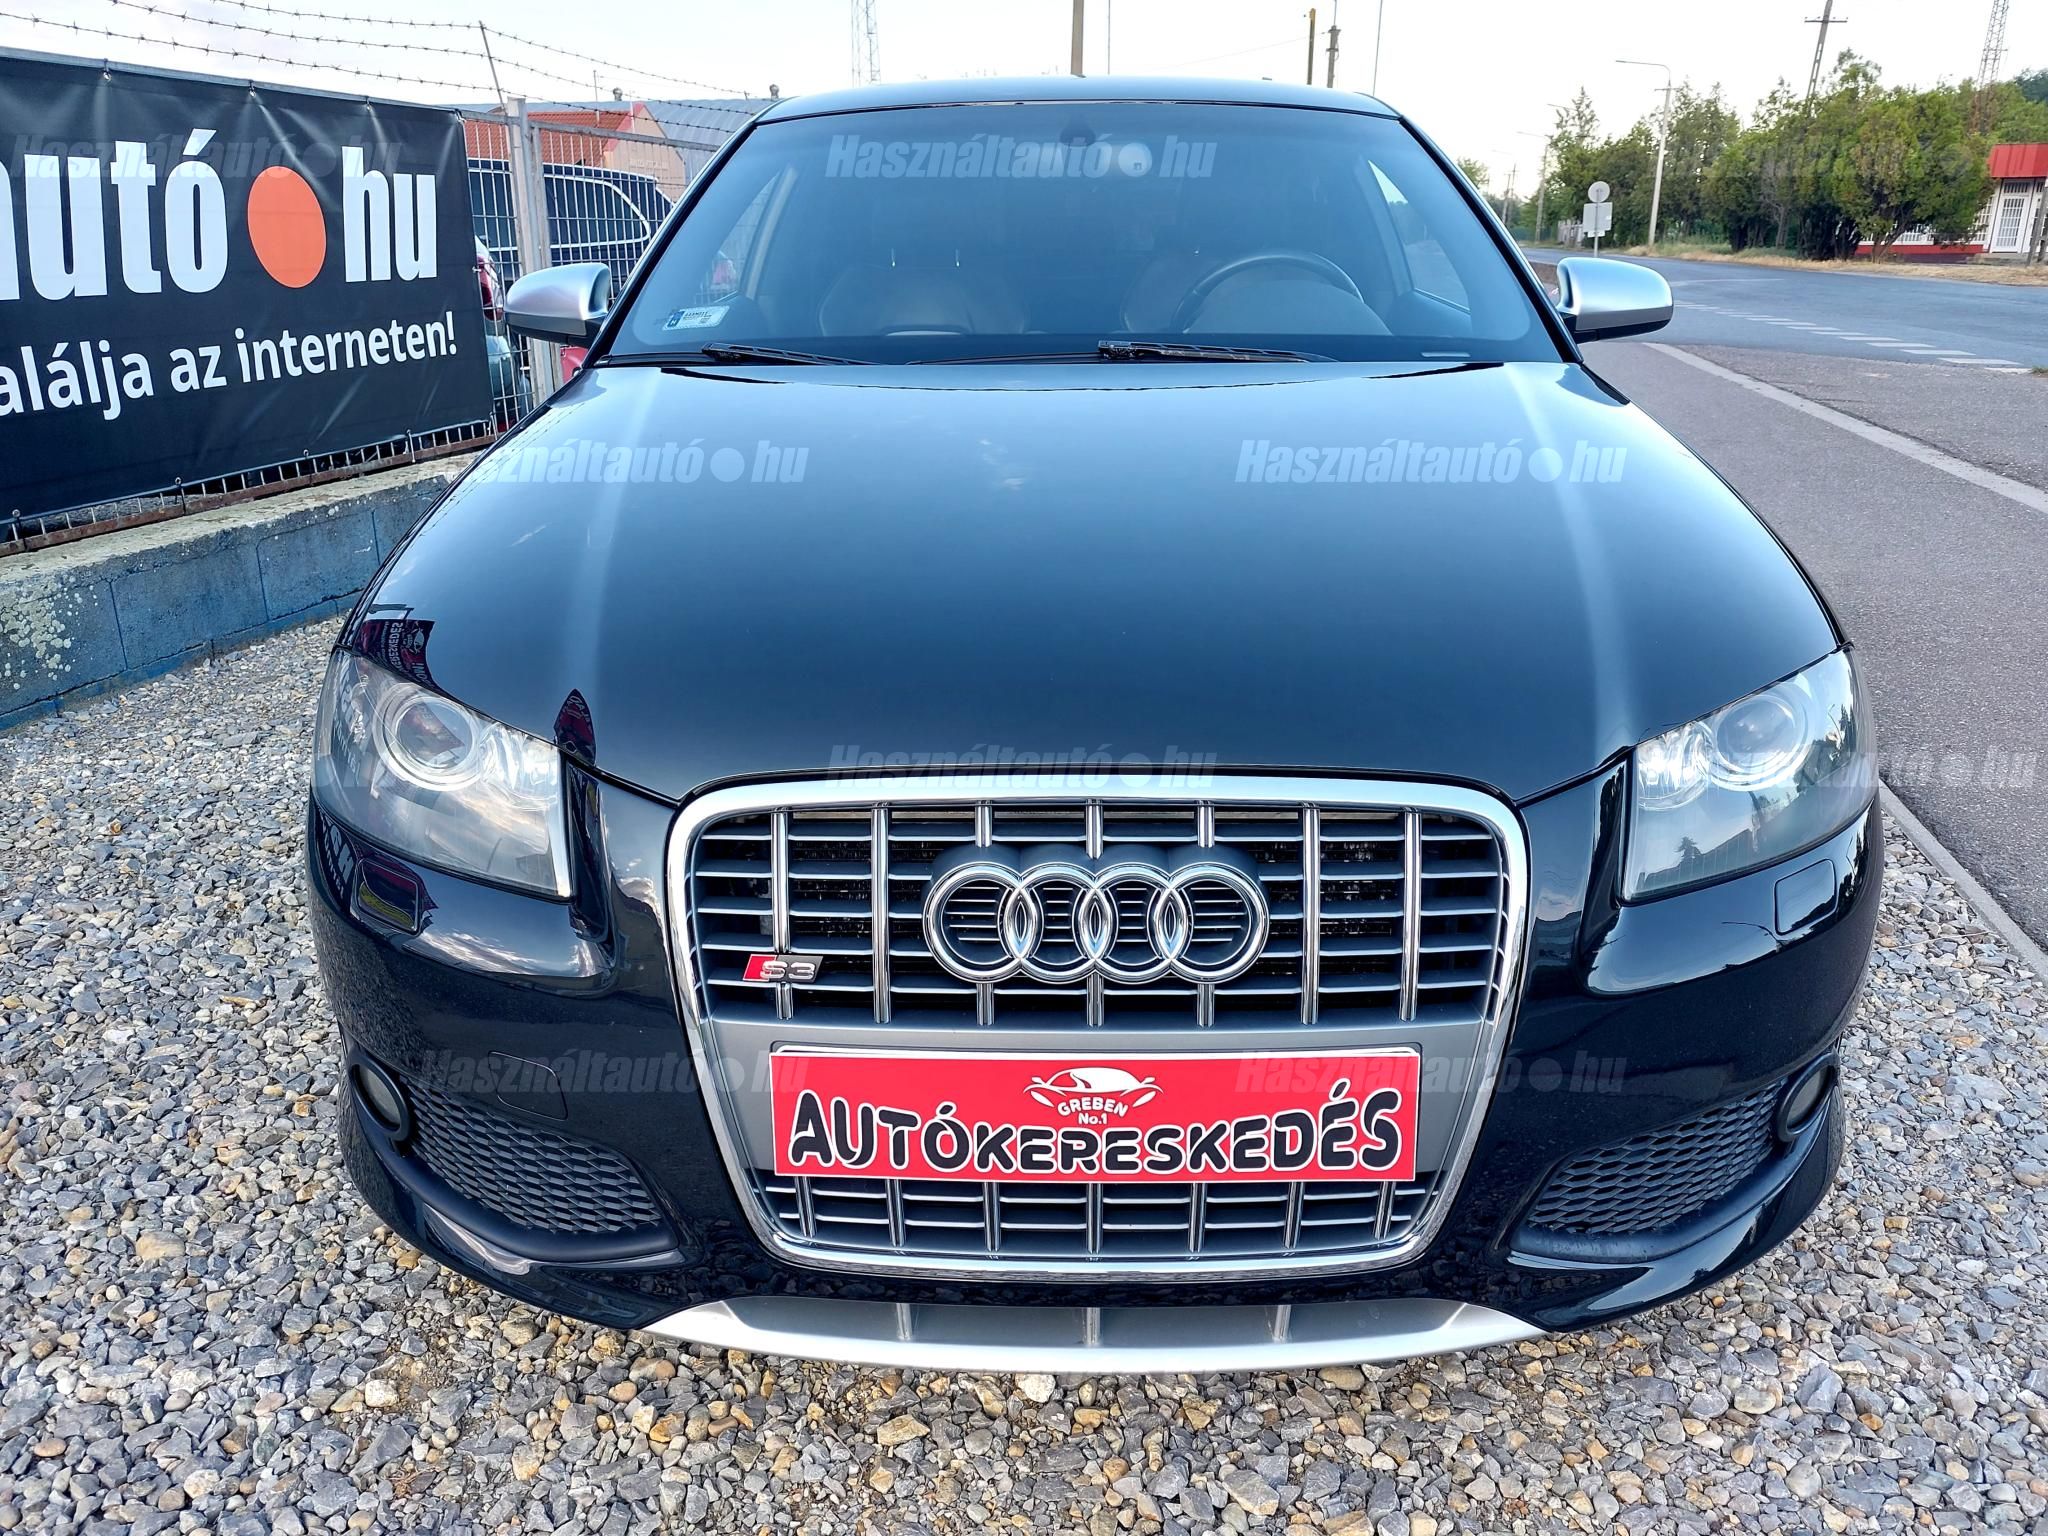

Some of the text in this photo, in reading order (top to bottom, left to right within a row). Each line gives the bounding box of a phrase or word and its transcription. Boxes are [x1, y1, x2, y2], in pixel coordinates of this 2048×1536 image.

[341, 146, 437, 283] hu
[169, 346, 227, 393] az
[235, 311, 457, 383] interneten!
[760, 960, 815, 980] S3
[787, 1077, 1403, 1173] AUTÓKERESKEDÉS
[1057, 1096, 1129, 1117] GREBEN
[1078, 1112, 1107, 1125] No.1
